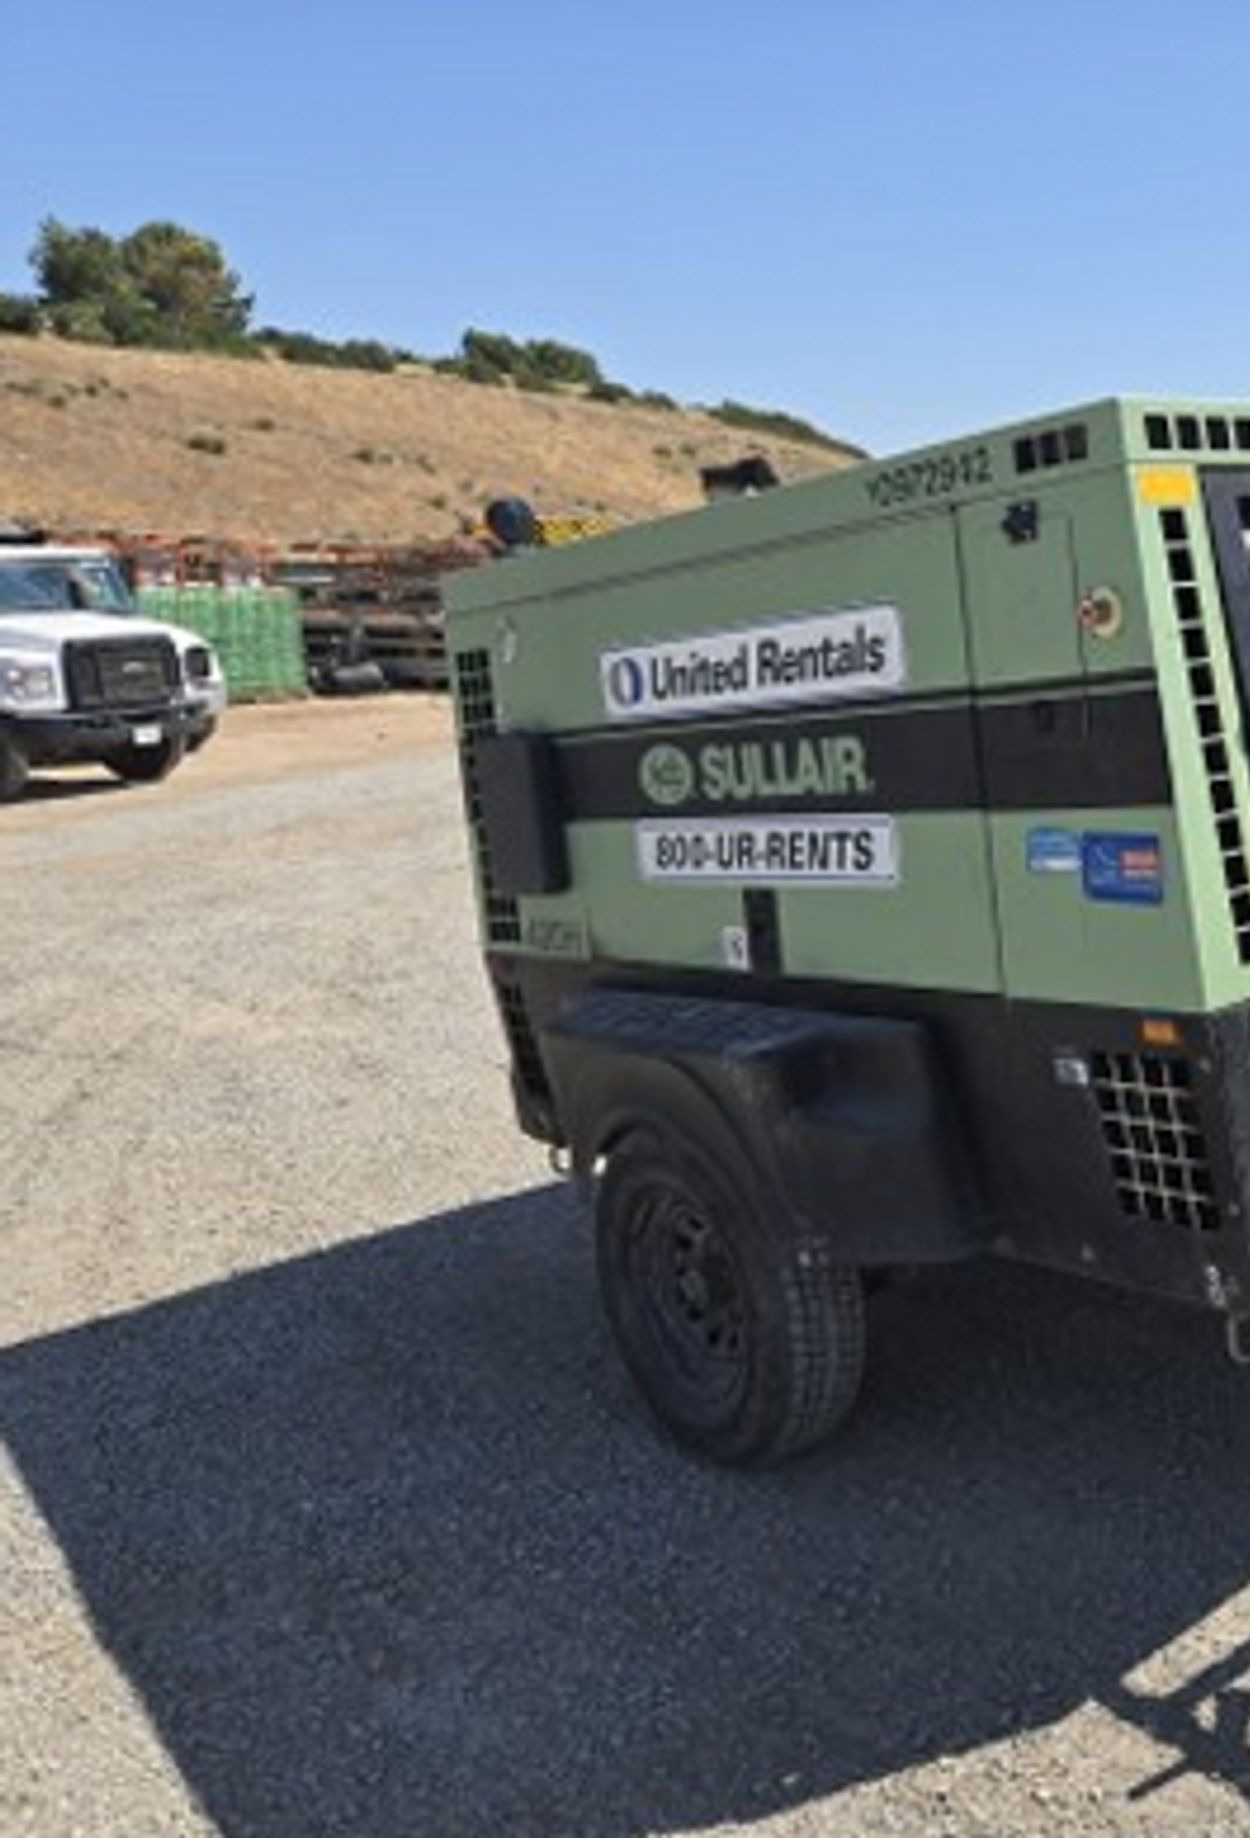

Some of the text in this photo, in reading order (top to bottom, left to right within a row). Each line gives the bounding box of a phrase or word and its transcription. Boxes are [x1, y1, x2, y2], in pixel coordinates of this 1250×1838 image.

[651, 624, 887, 700] United Rentals
[701, 736, 869, 800] SULLAIR
[655, 830, 875, 872] 800-UR-RENTS
